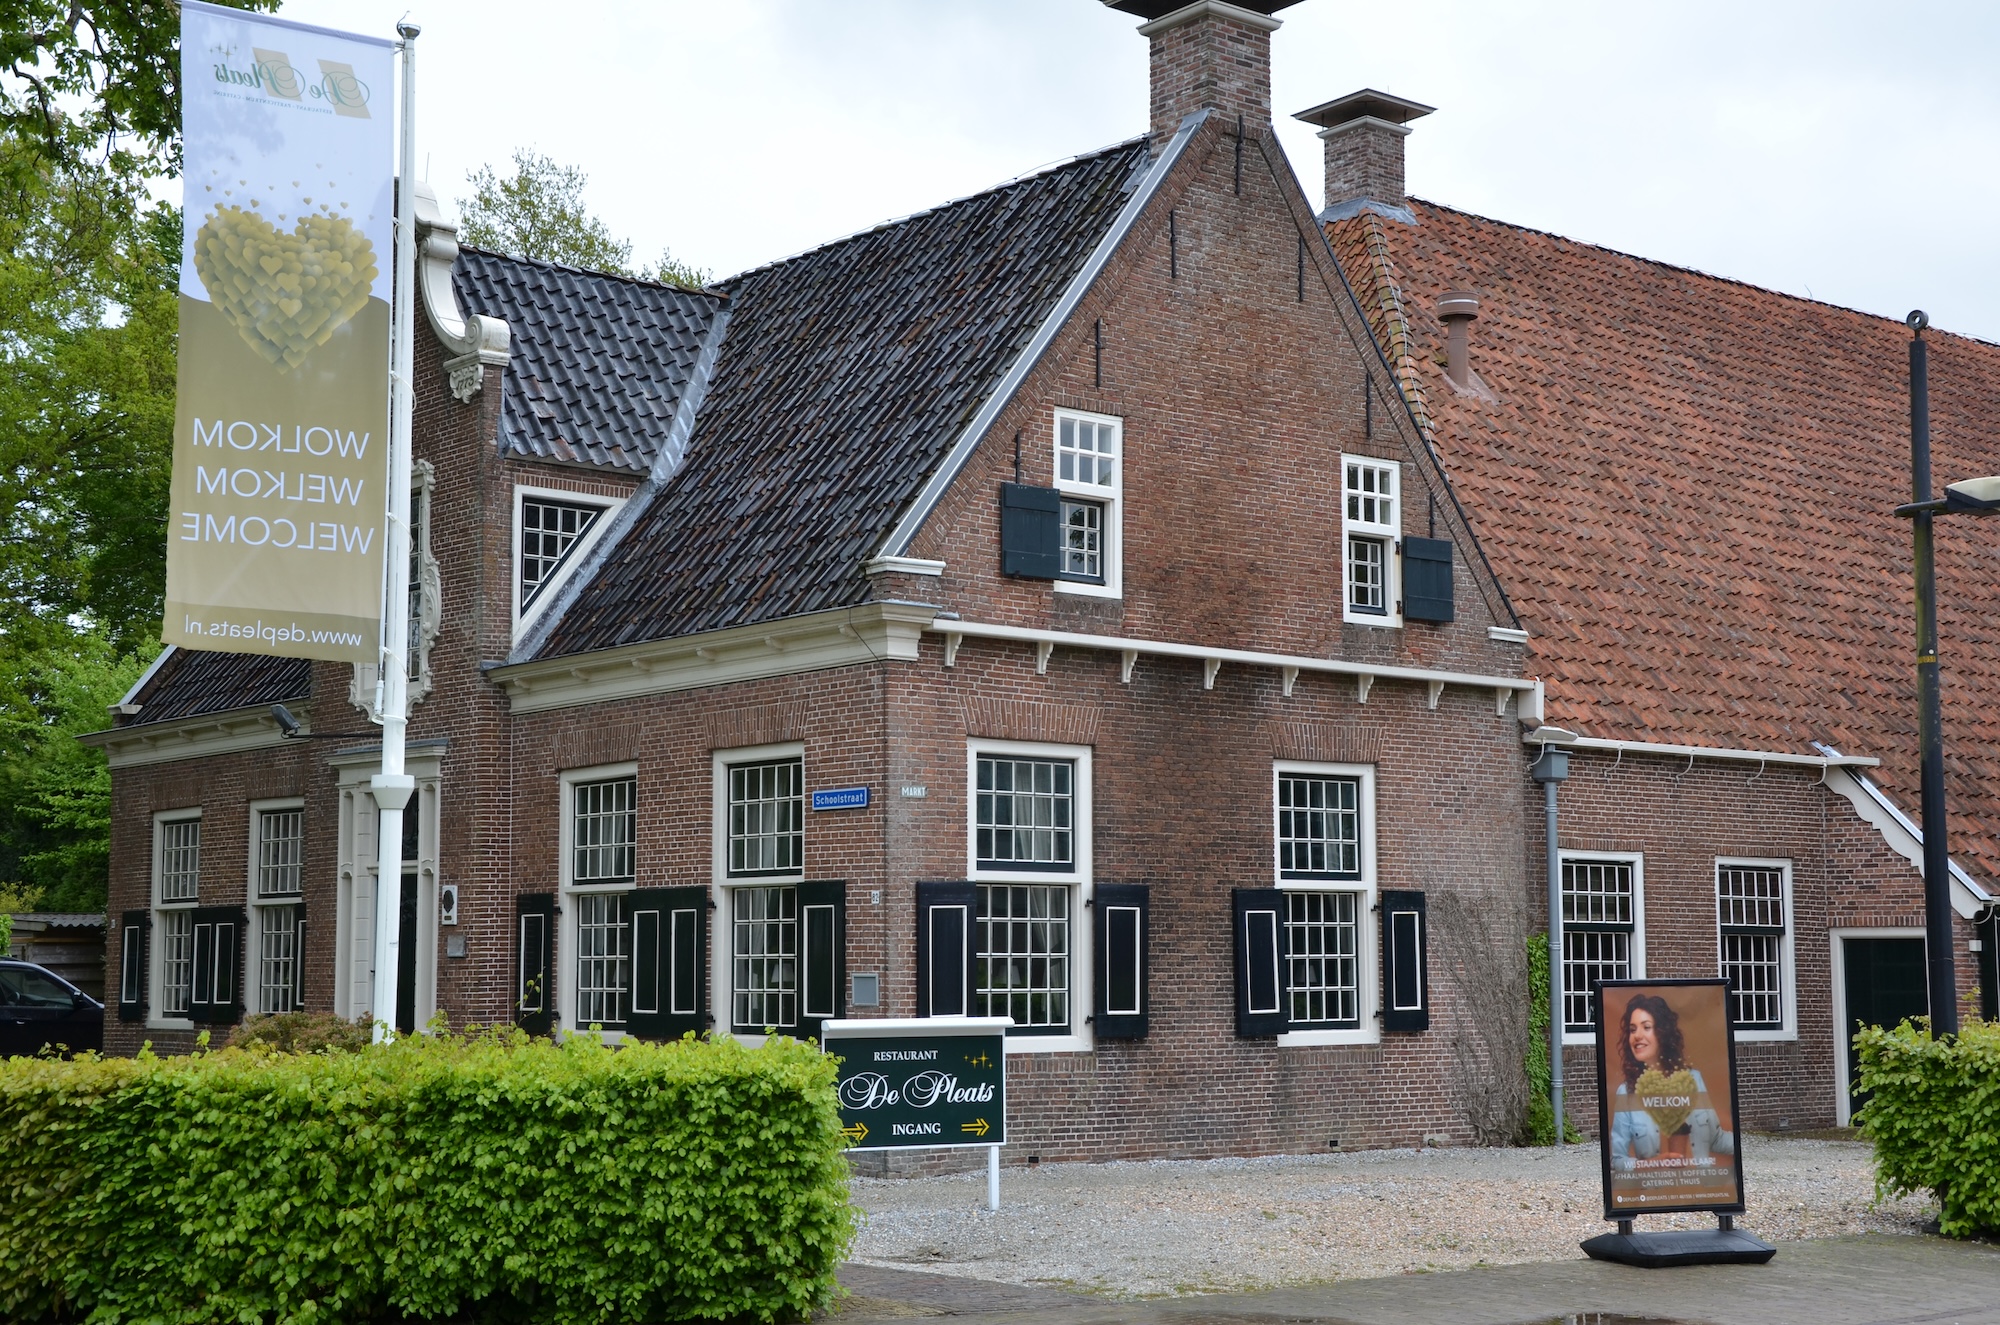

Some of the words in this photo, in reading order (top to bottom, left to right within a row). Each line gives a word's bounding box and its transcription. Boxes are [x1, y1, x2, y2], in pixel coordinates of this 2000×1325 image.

[213, 89, 241, 100] CATERING
[901, 786, 926, 797] MARKT
[815, 793, 864, 806] Schoolstraat
[873, 1050, 938, 1062] RESTAURANT
[838, 1071, 900, 1110] De
[902, 1070, 995, 1108] Pleats
[1642, 1096, 1690, 1108] WELKOM
[892, 1122, 941, 1136] INGANG
[1636, 1160, 1659, 1169] STAAN
[1660, 1158, 1682, 1168] VOOR
[1682, 1158, 1689, 1166] U
[1690, 1157, 1716, 1166] KLAAR!
[1682, 1169, 1707, 1177] KOFFIE
[1707, 1168, 1717, 1176] TO
[1718, 1168, 1729, 1176] GO
